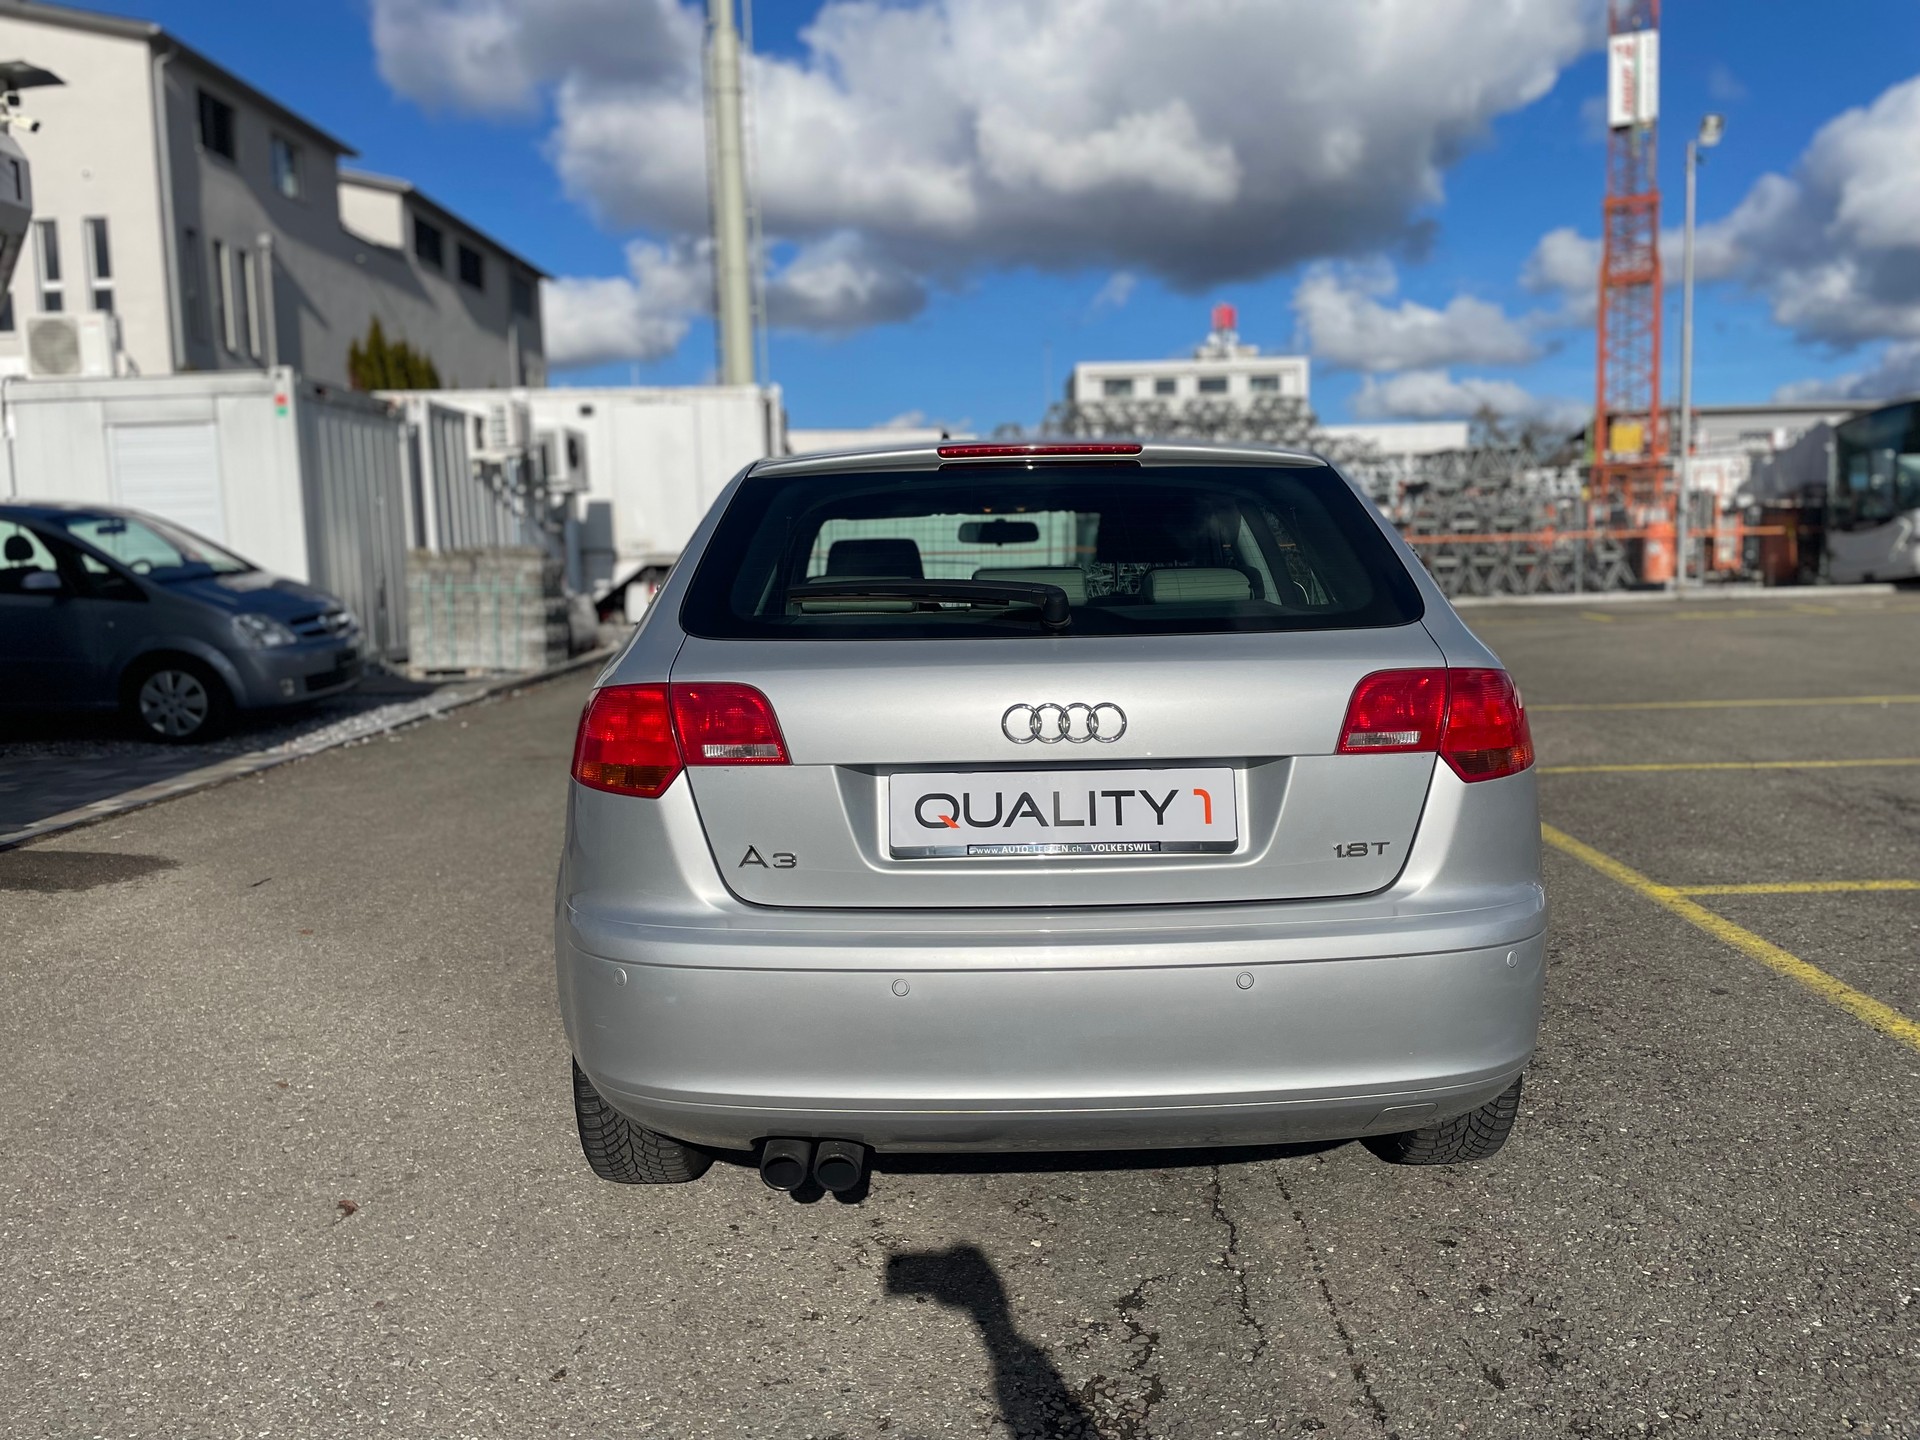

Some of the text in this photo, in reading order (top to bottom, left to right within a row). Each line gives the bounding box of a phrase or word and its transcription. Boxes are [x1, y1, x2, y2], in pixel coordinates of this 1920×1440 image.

[914, 788, 1212, 829] QUALITY 1
[738, 844, 797, 869] A3
[1091, 843, 1153, 852] VOLKETSWIL
